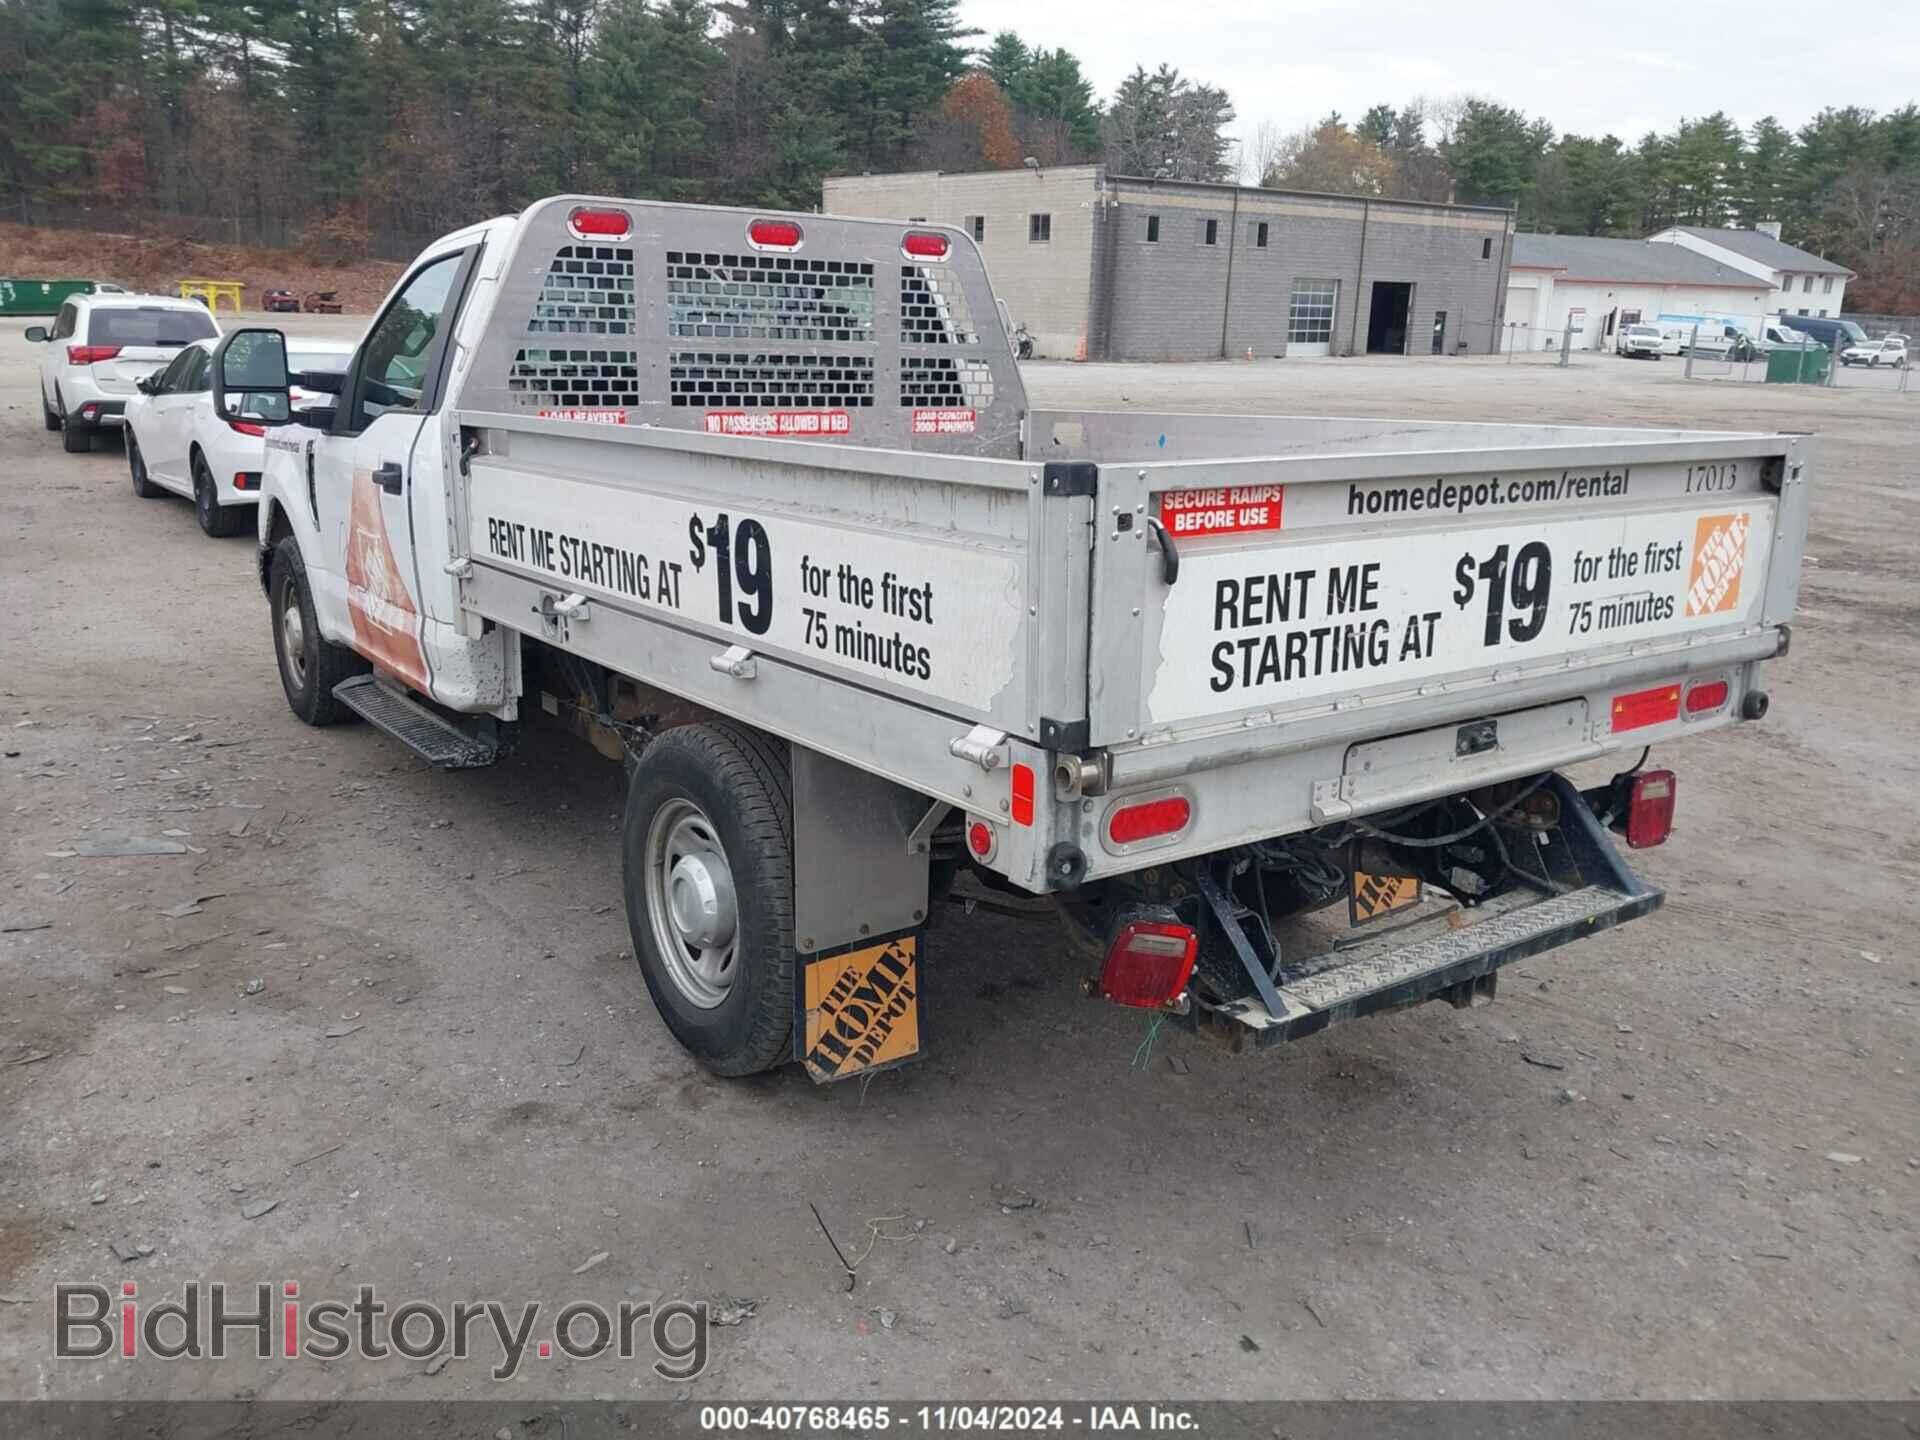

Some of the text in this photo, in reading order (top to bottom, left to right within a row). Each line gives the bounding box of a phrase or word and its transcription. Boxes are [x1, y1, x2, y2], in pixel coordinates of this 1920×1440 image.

[707, 414, 721, 433] NO
[780, 414, 819, 432] ALLOWED
[820, 414, 830, 431] IN
[831, 414, 849, 431] BED
[917, 411, 973, 420] LOAD CAPACITY
[1164, 486, 1280, 510] SECURE RAMPS
[1347, 468, 1630, 515] homedepot.com/rental
[1685, 463, 1737, 493] 17013
[1175, 507, 1269, 532] BEFORE USE
[488, 517, 683, 609] RENT ME STARTING AT
[688, 511, 773, 636] $19
[801, 555, 933, 625] for the first
[1213, 562, 1381, 631] RENT ME
[1453, 540, 1552, 647] $19
[1573, 540, 1683, 584] for the first
[1688, 514, 1748, 615] HOME
[801, 606, 931, 681] 75 minutes
[1569, 593, 1675, 636] 75 minutes
[1209, 611, 1442, 693] STARTING AT
[807, 941, 915, 1074] HOME
[818, 966, 862, 1016] THE
[853, 981, 916, 1065] DEPOT
